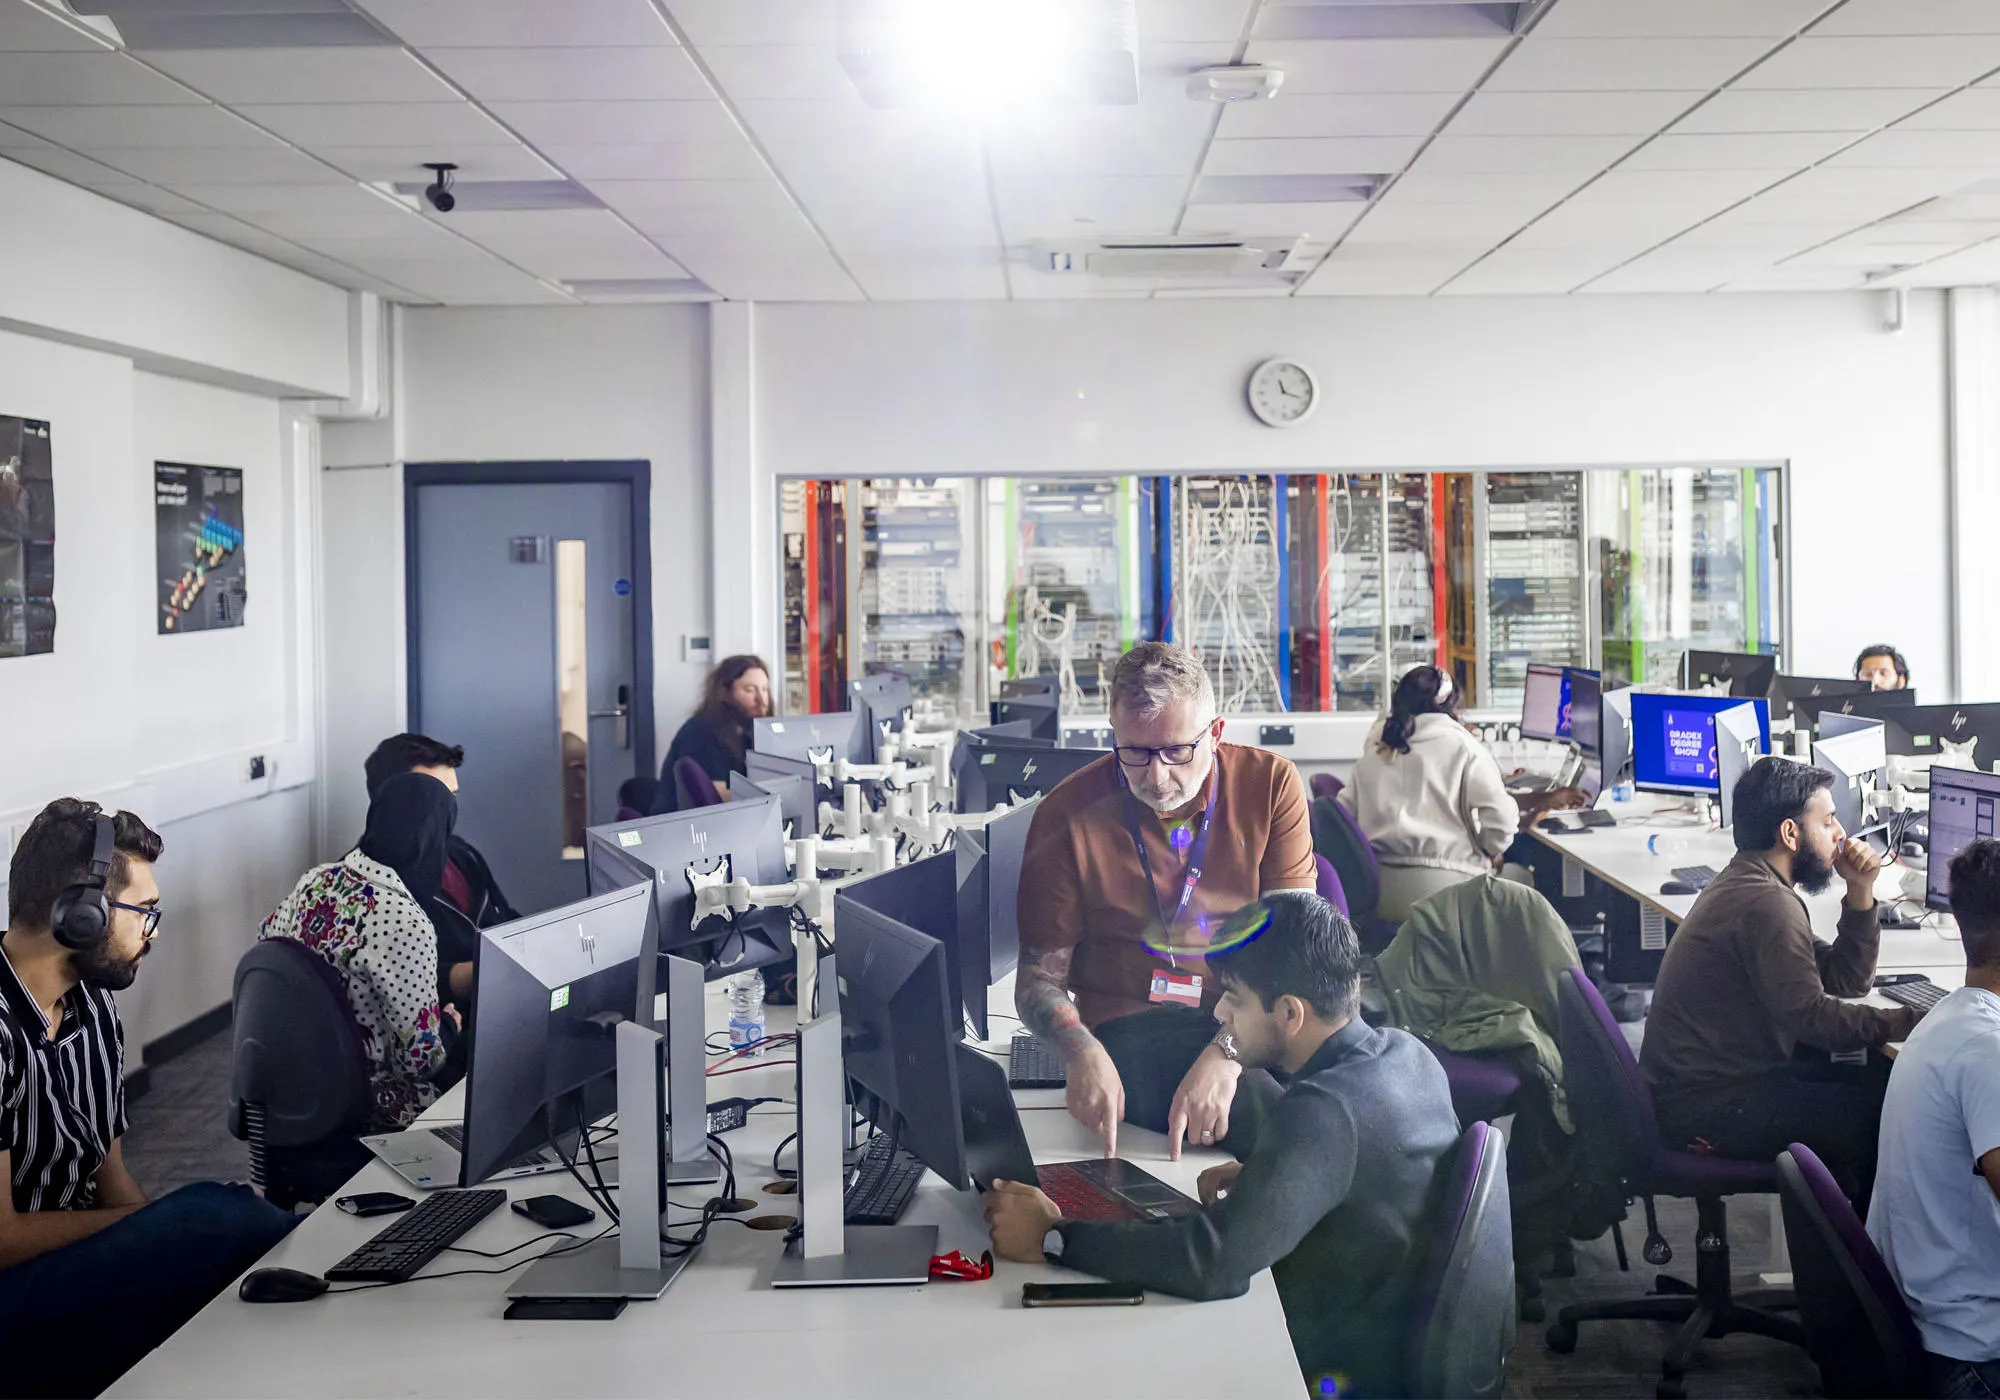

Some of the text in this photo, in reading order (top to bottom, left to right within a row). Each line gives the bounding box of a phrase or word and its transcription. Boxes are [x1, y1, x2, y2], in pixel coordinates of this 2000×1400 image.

[1951, 710, 1967, 732] hp
[1670, 739, 1702, 749] DEGREE
[1674, 748, 1700, 757] SHOW
[1022, 757, 1038, 781] hp
[690, 823, 707, 853] hp
[578, 923, 595, 965] hp
